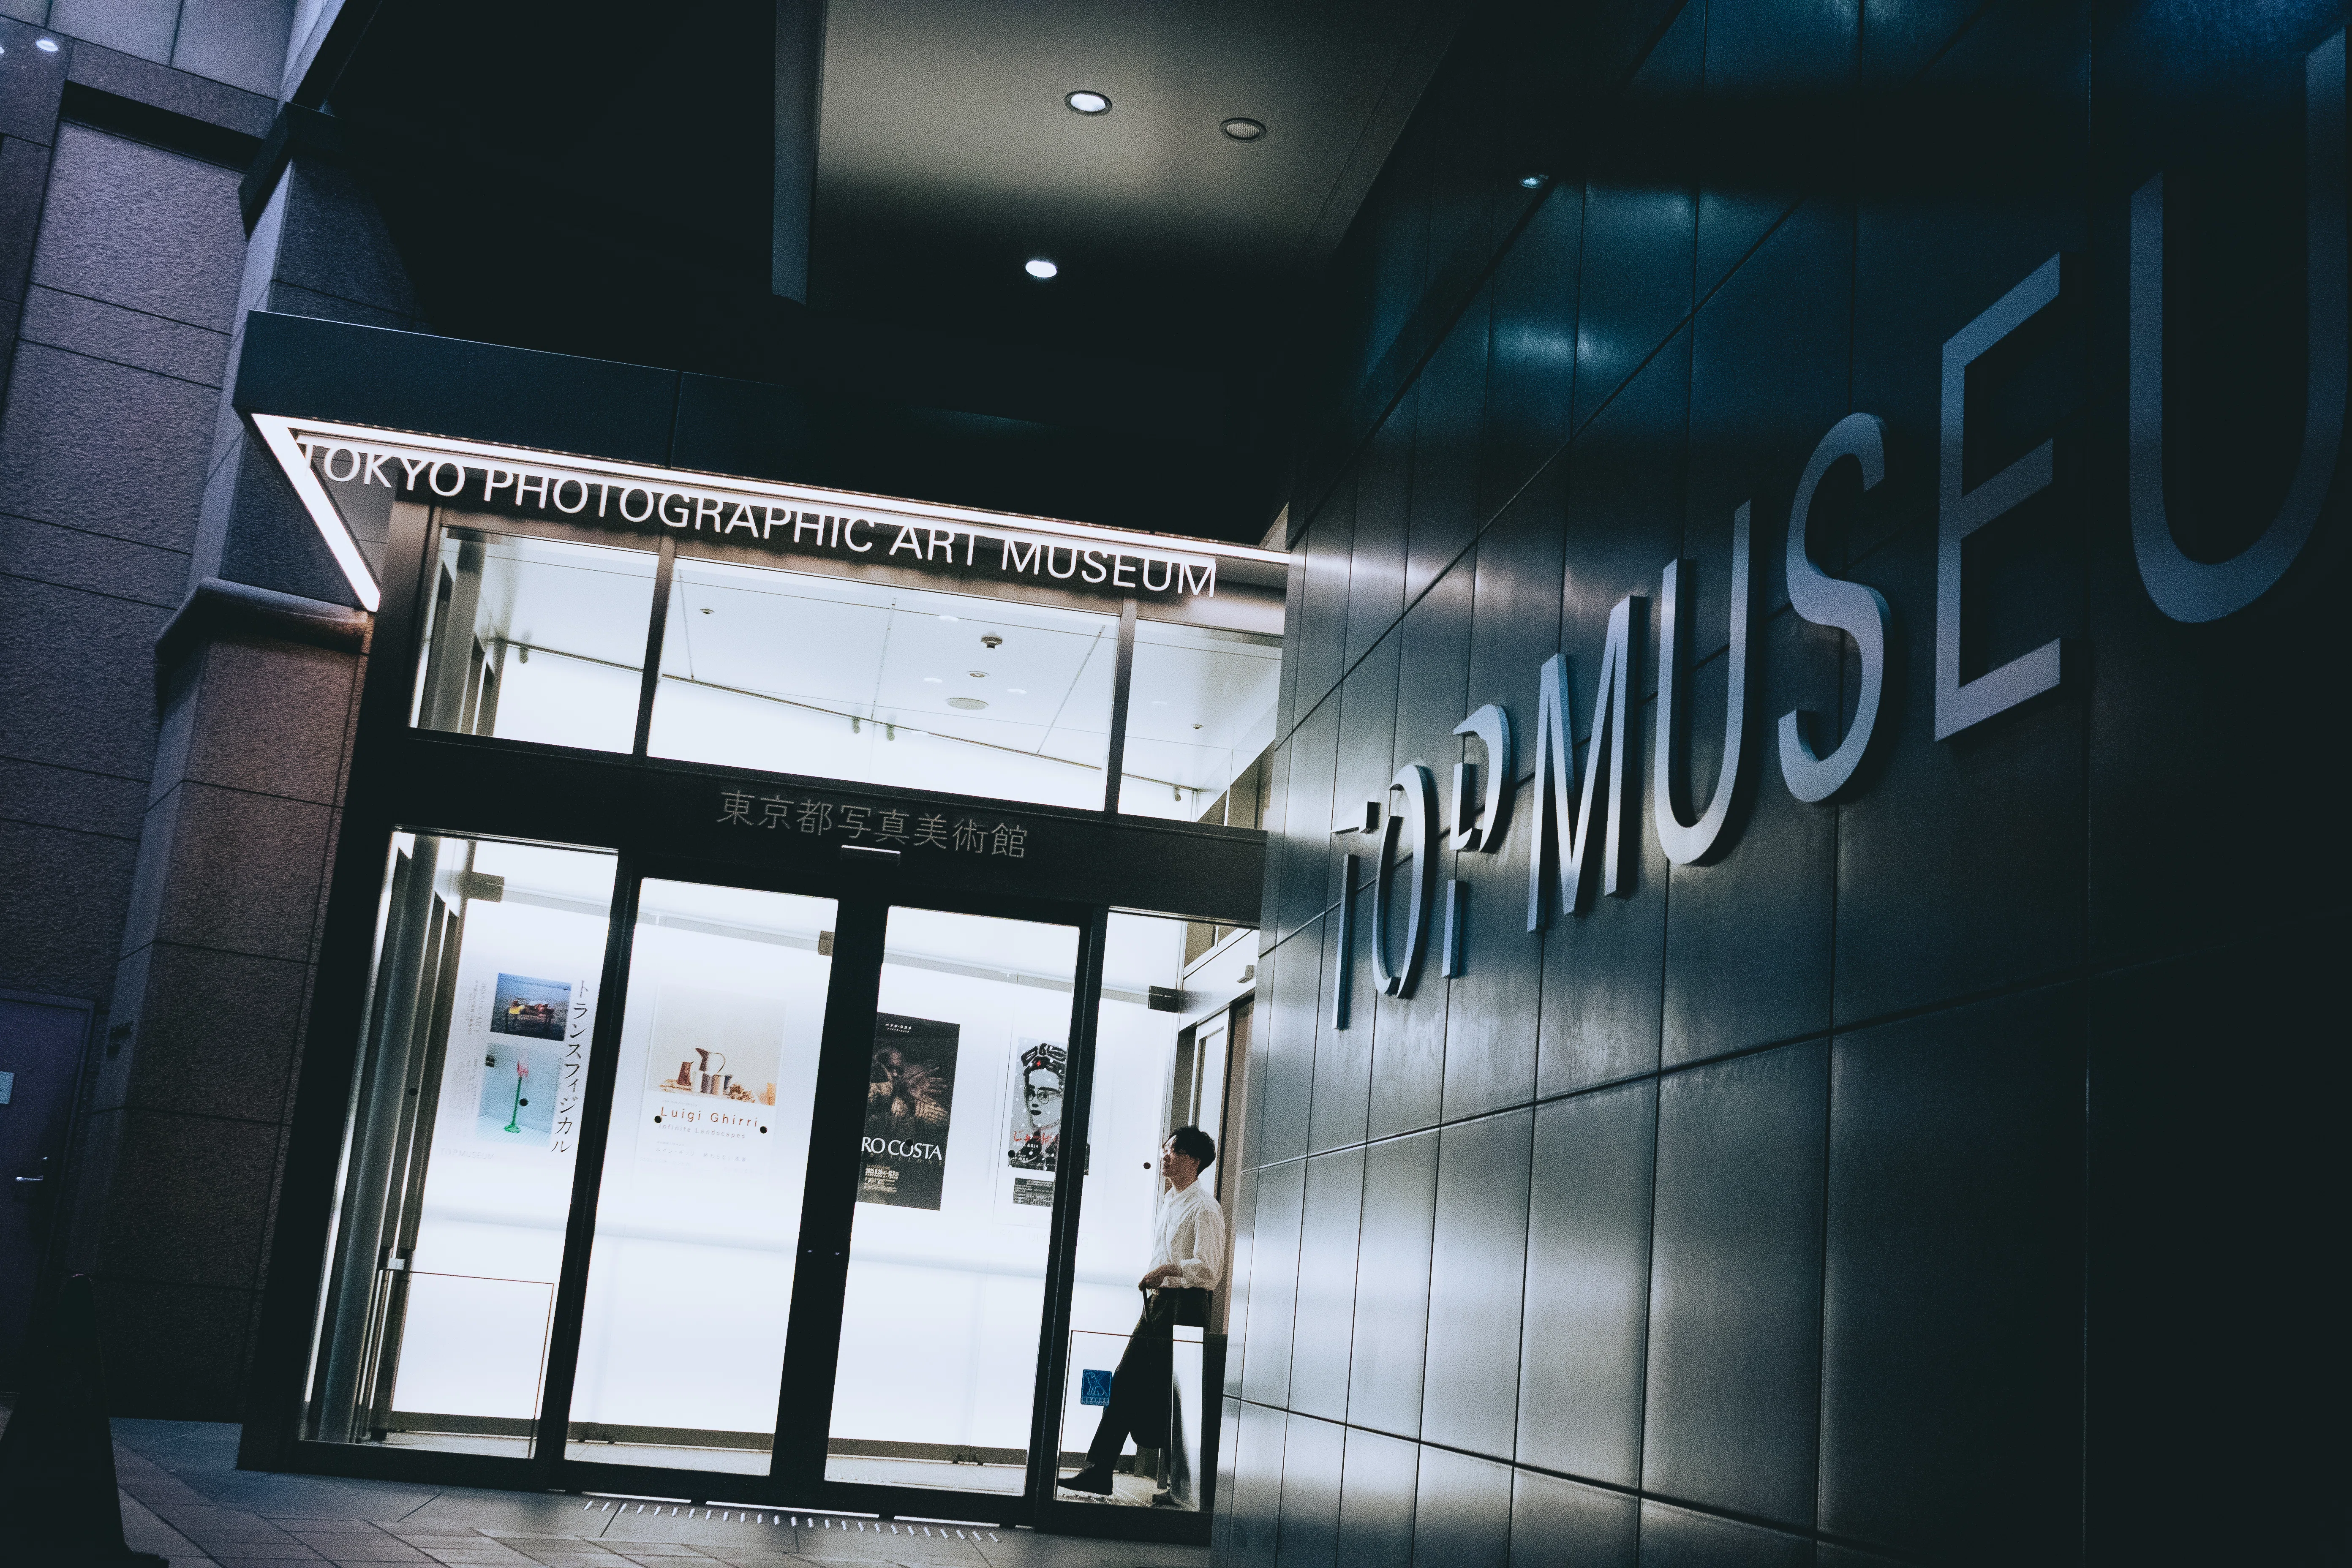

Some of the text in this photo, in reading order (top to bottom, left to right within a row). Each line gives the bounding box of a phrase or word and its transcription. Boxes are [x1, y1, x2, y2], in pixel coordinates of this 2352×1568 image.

[300, 441, 1216, 597] TOKYO PHOTOGRAPHIC ART MUSEUM
[716, 789, 1028, 859] 東京都写真美術館
[1330, 703, 1512, 1031] TOP
[551, 980, 589, 1153] トランスフィジカル
[659, 1123, 746, 1139] Infinite Landscapes
[660, 1106, 758, 1127] Luigi Ghirri
[861, 1136, 886, 1154] RO
[888, 1139, 942, 1161] COSTA
